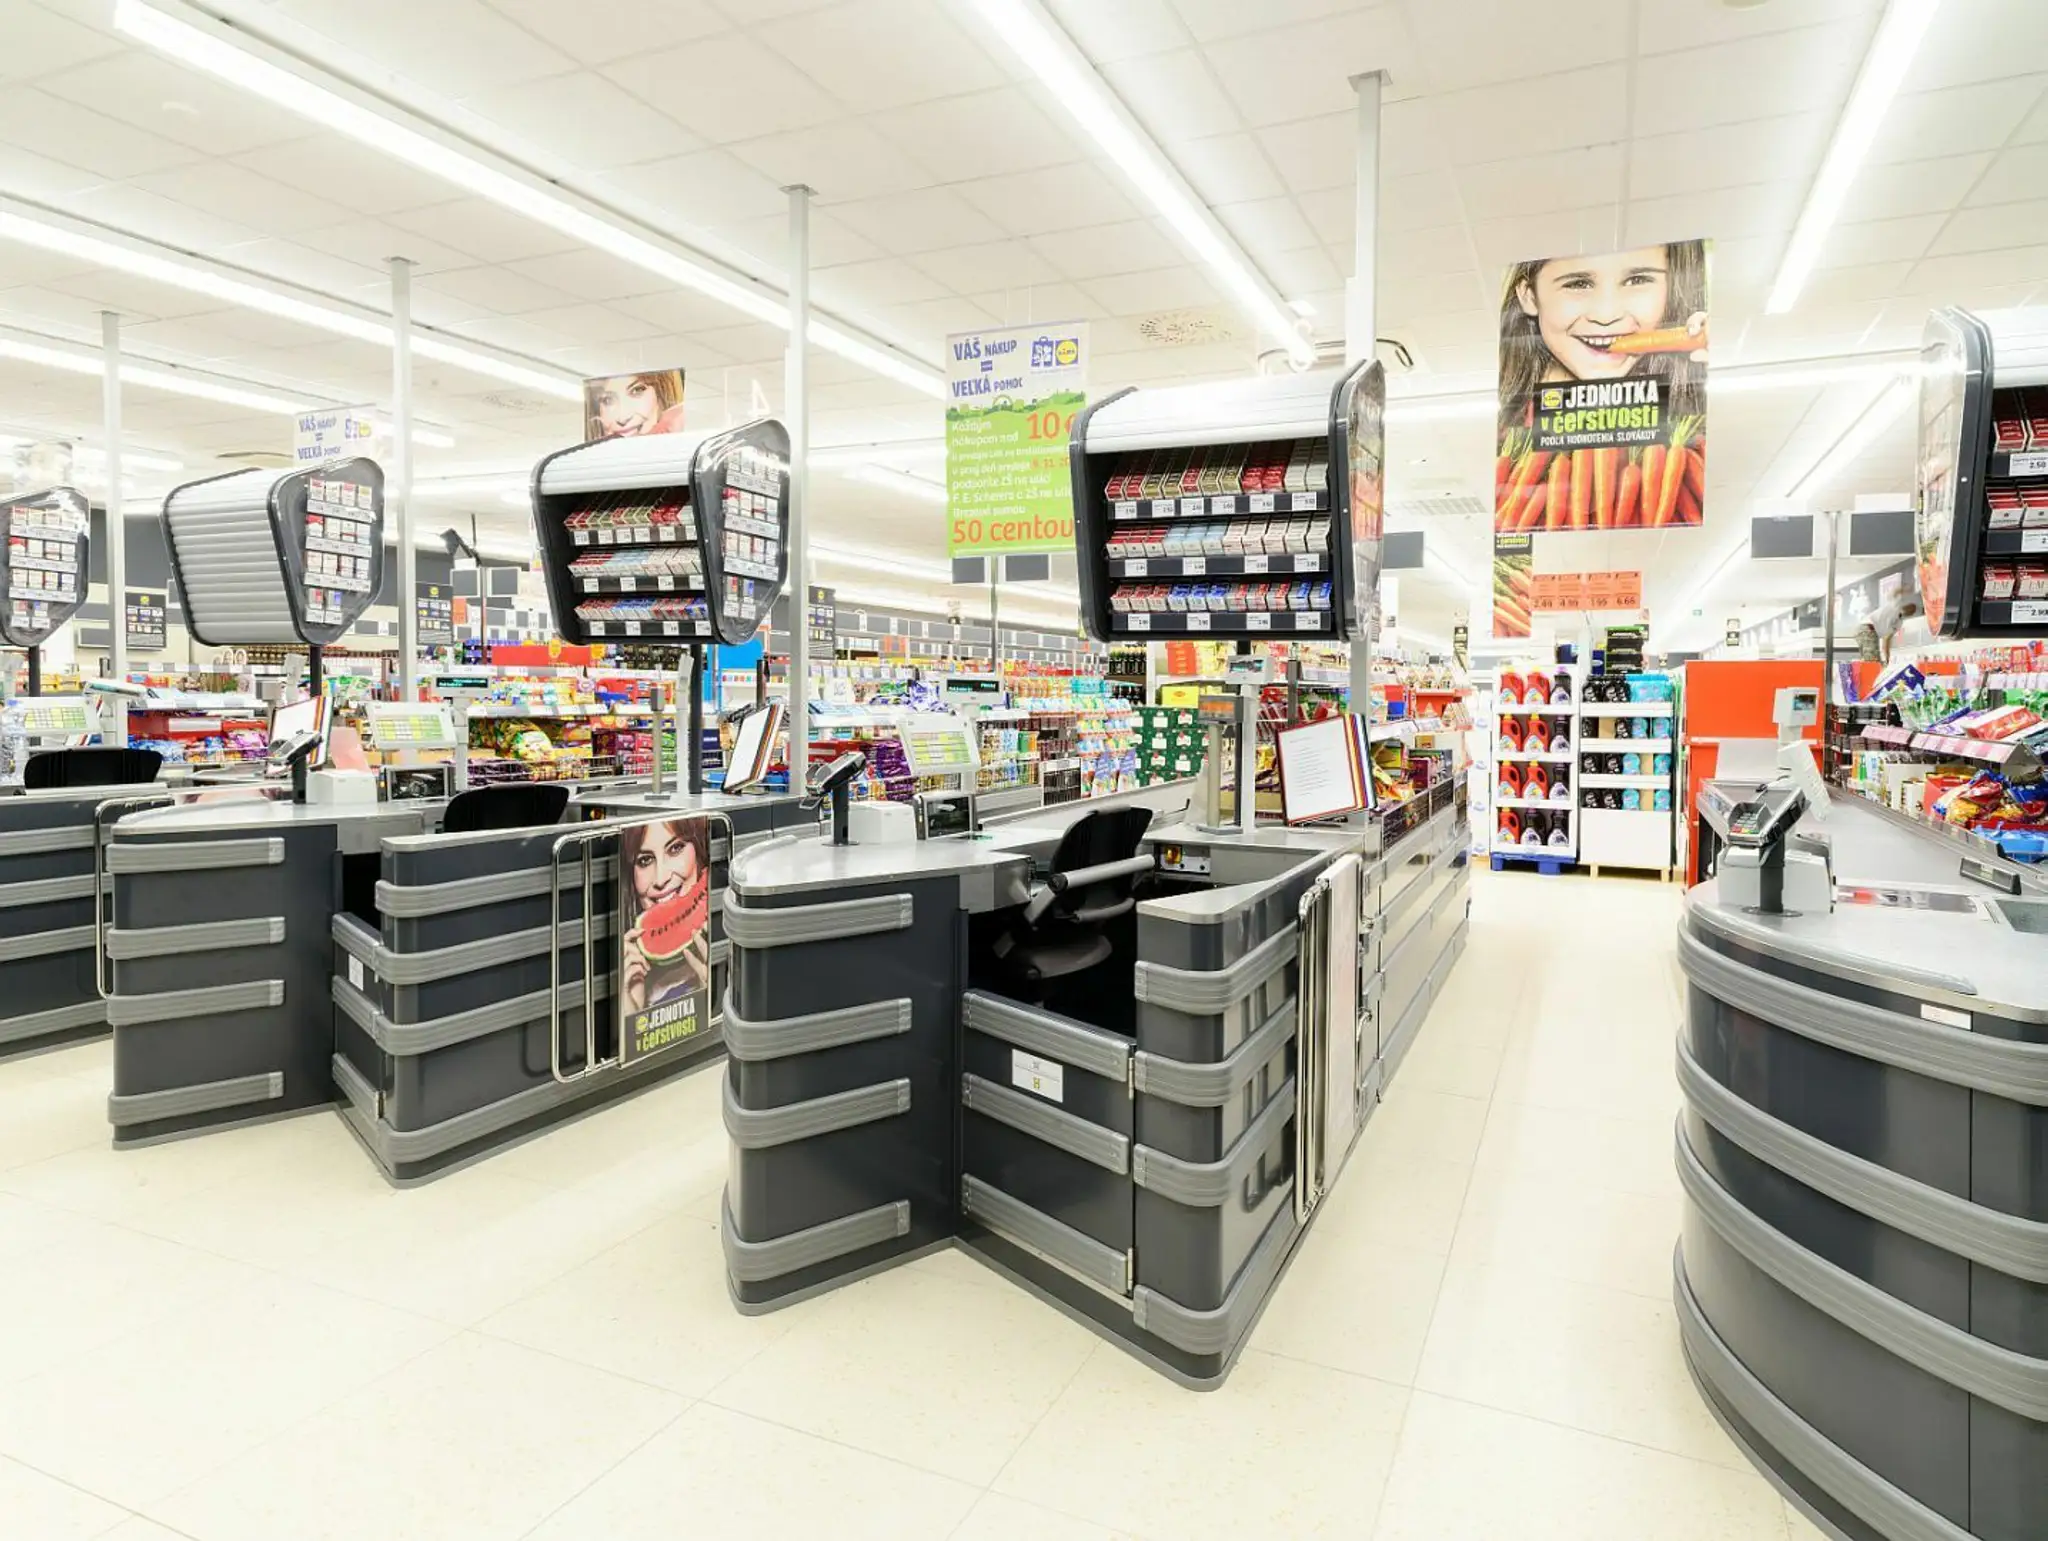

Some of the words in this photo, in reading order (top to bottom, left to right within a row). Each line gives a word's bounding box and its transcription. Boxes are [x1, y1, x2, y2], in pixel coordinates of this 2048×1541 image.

[953, 336, 981, 361] VÁŠ
[984, 340, 1018, 357] NÁKUP
[1565, 380, 1659, 409] JEDNOTKA
[1026, 411, 1061, 440] 10
[1541, 416, 1549, 431] v
[1552, 404, 1659, 434] čerstvosti
[953, 518, 983, 544] 50
[650, 998, 695, 1028] JEDNOTKA
[643, 1016, 696, 1051] čerstvosti
